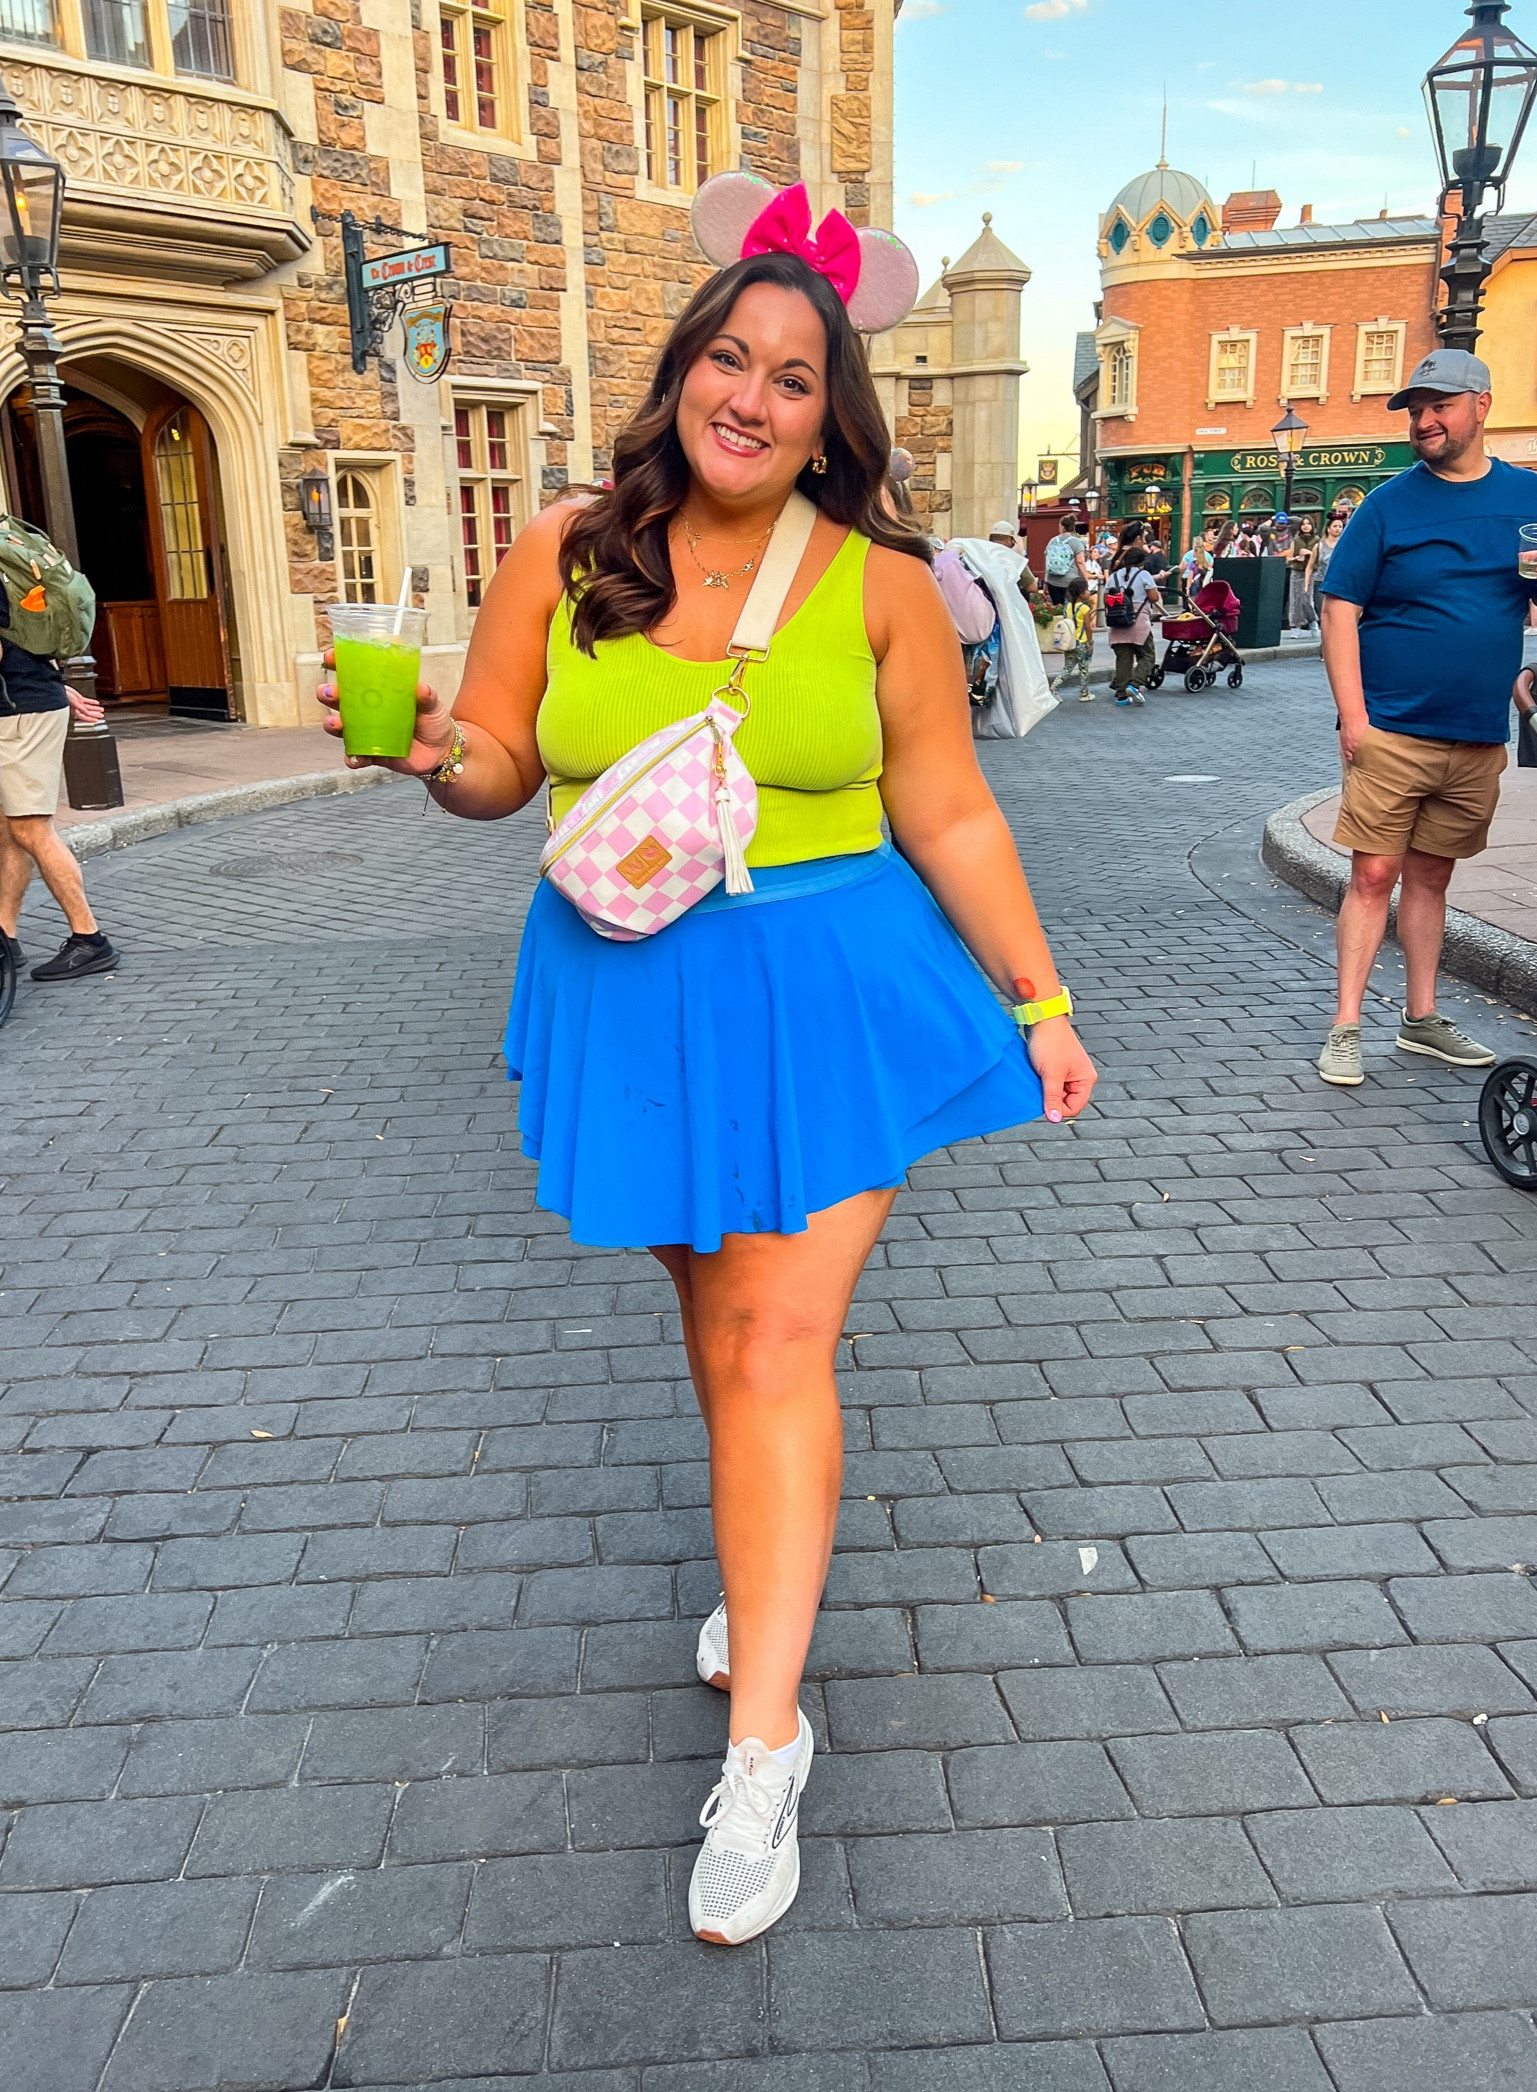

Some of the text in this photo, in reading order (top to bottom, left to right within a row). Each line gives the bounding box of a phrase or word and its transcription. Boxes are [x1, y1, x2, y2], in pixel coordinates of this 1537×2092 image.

[1245, 451, 1371, 468] ROS & CROWN
[1130, 463, 1166, 478] PUB
